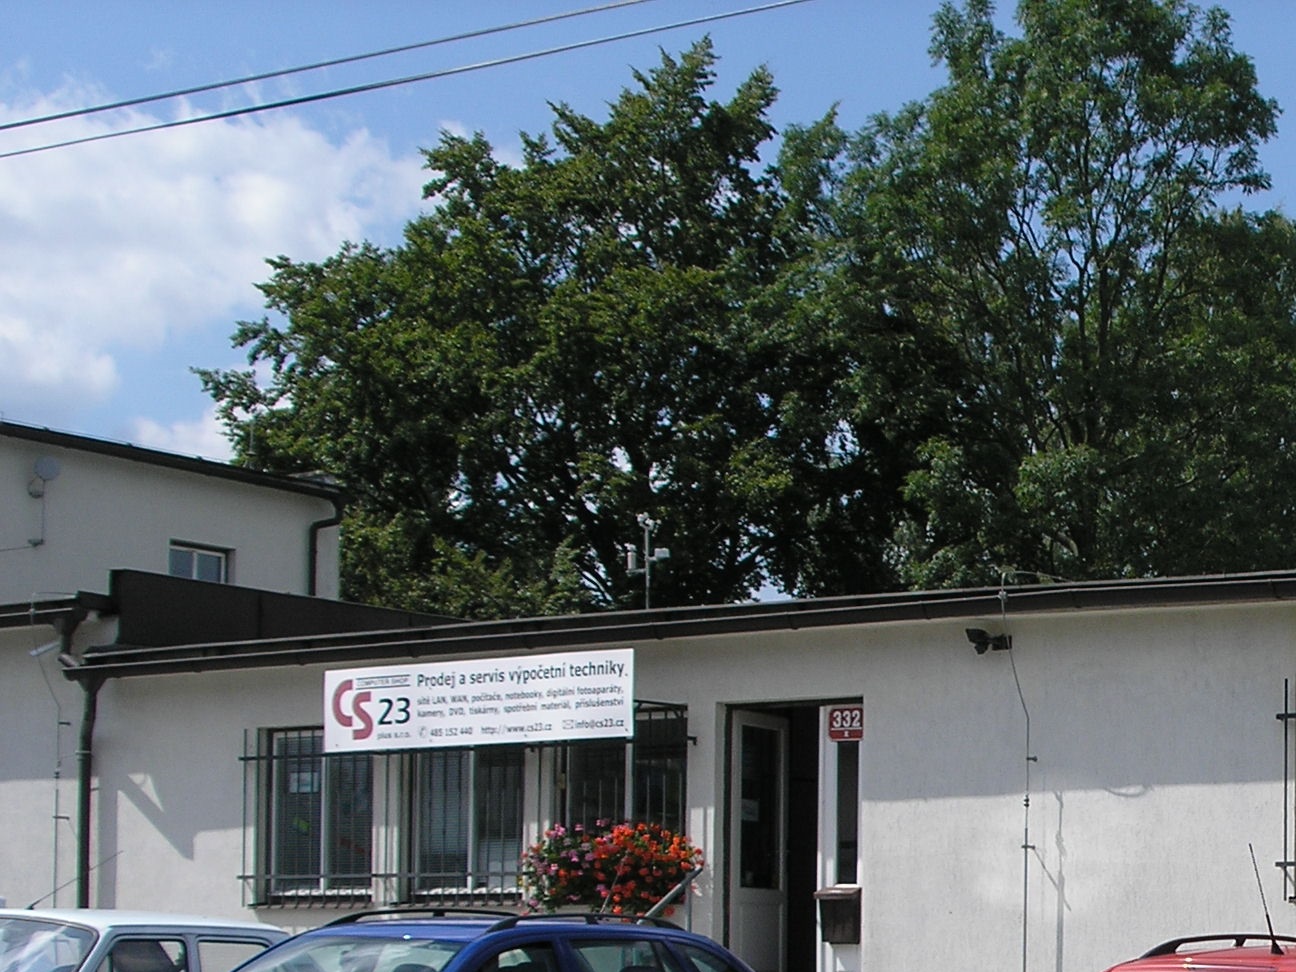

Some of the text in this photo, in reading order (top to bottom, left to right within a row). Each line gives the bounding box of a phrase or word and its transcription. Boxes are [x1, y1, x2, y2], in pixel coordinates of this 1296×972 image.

[416, 660, 625, 689] Prodej a servis výpočetní techniky
[377, 697, 411, 725] 23
[832, 710, 861, 728] 332
